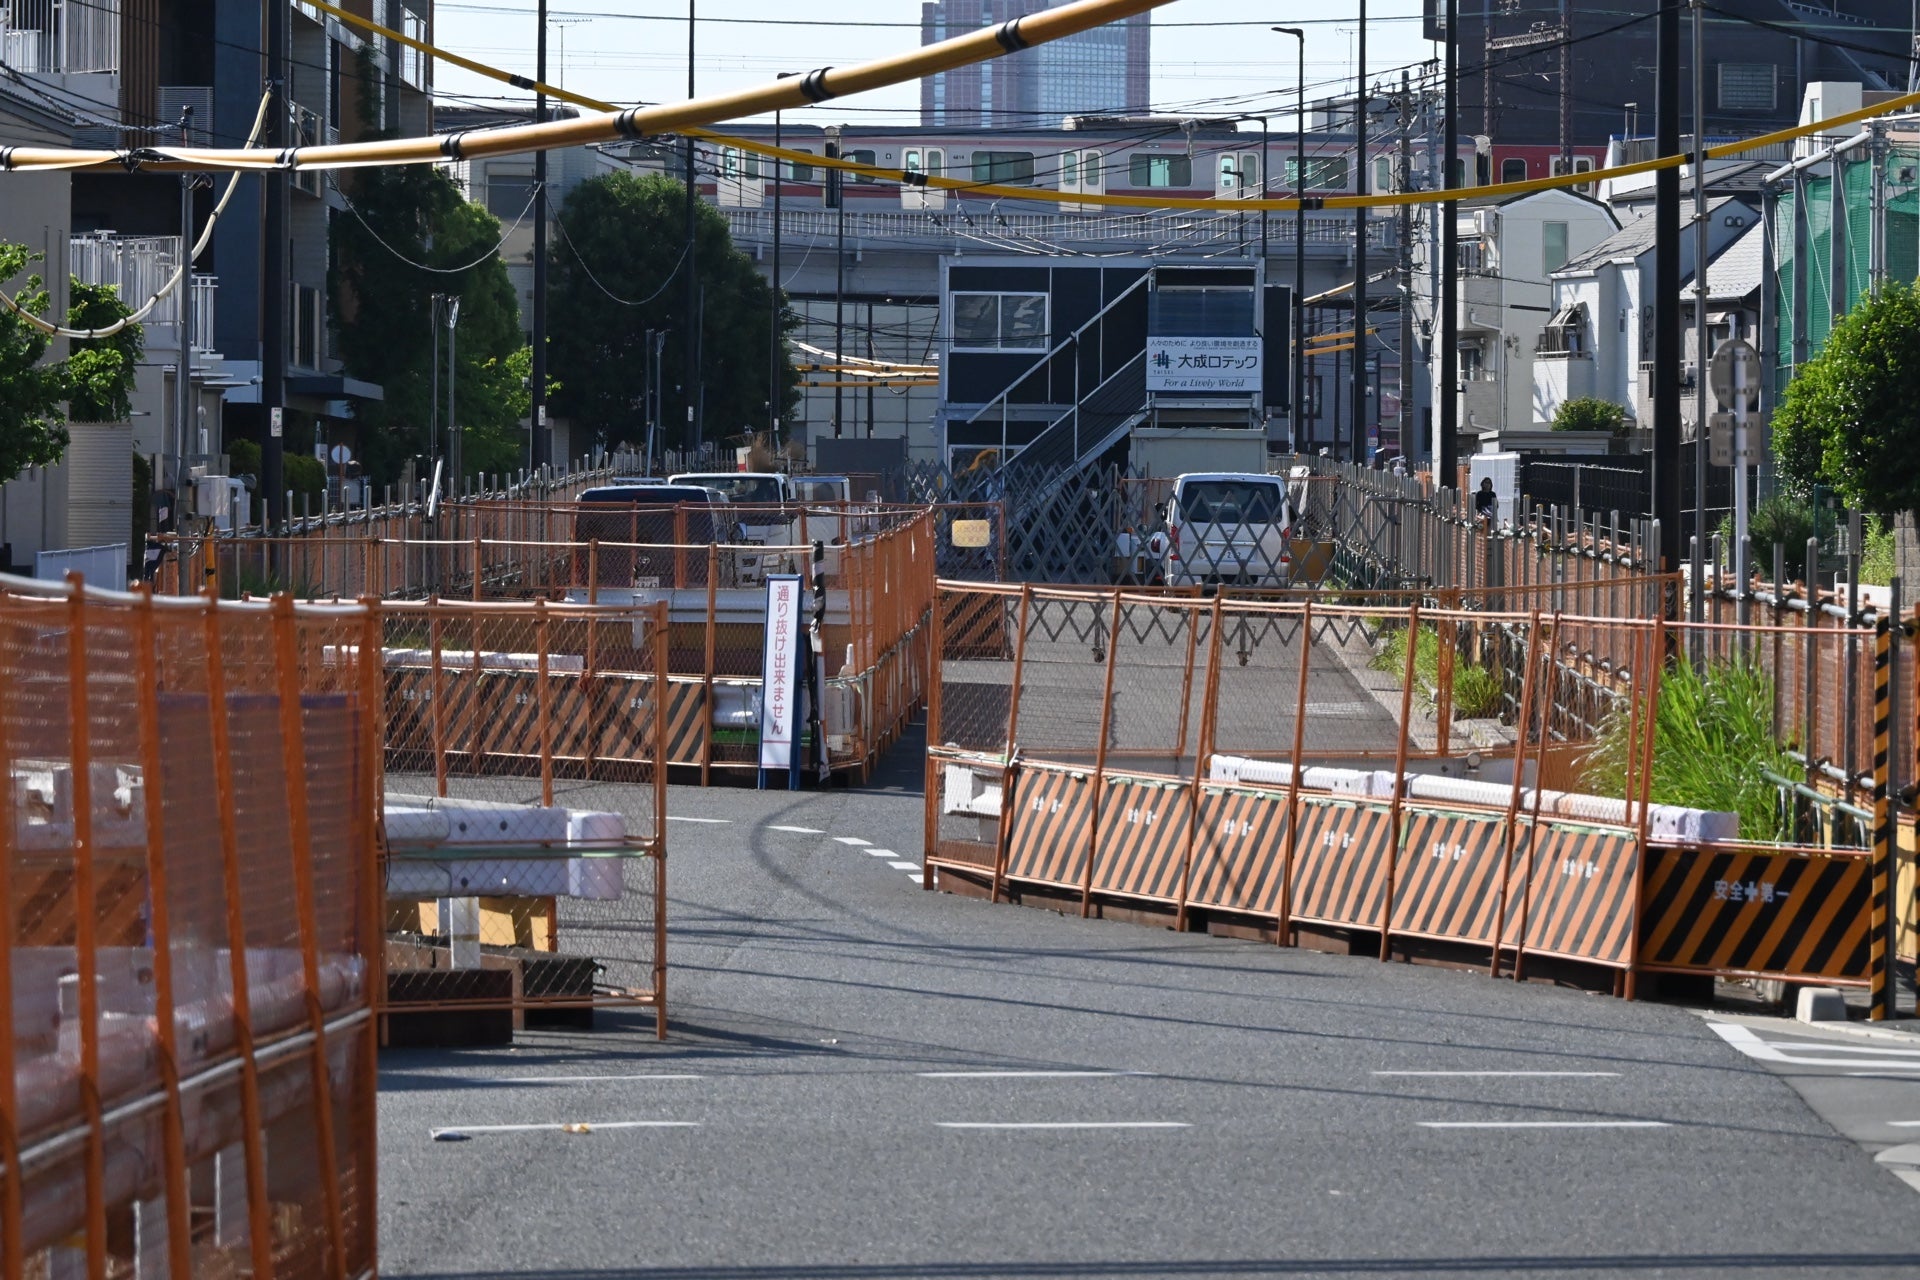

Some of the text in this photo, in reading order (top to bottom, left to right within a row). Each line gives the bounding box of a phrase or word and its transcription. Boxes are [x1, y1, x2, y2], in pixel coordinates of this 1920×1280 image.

[1178, 354, 1258, 369] 大成ロテック
[1163, 379, 1179, 387] For
[1218, 379, 1245, 387] World
[771, 585, 790, 736] 通り抜け出来ません
